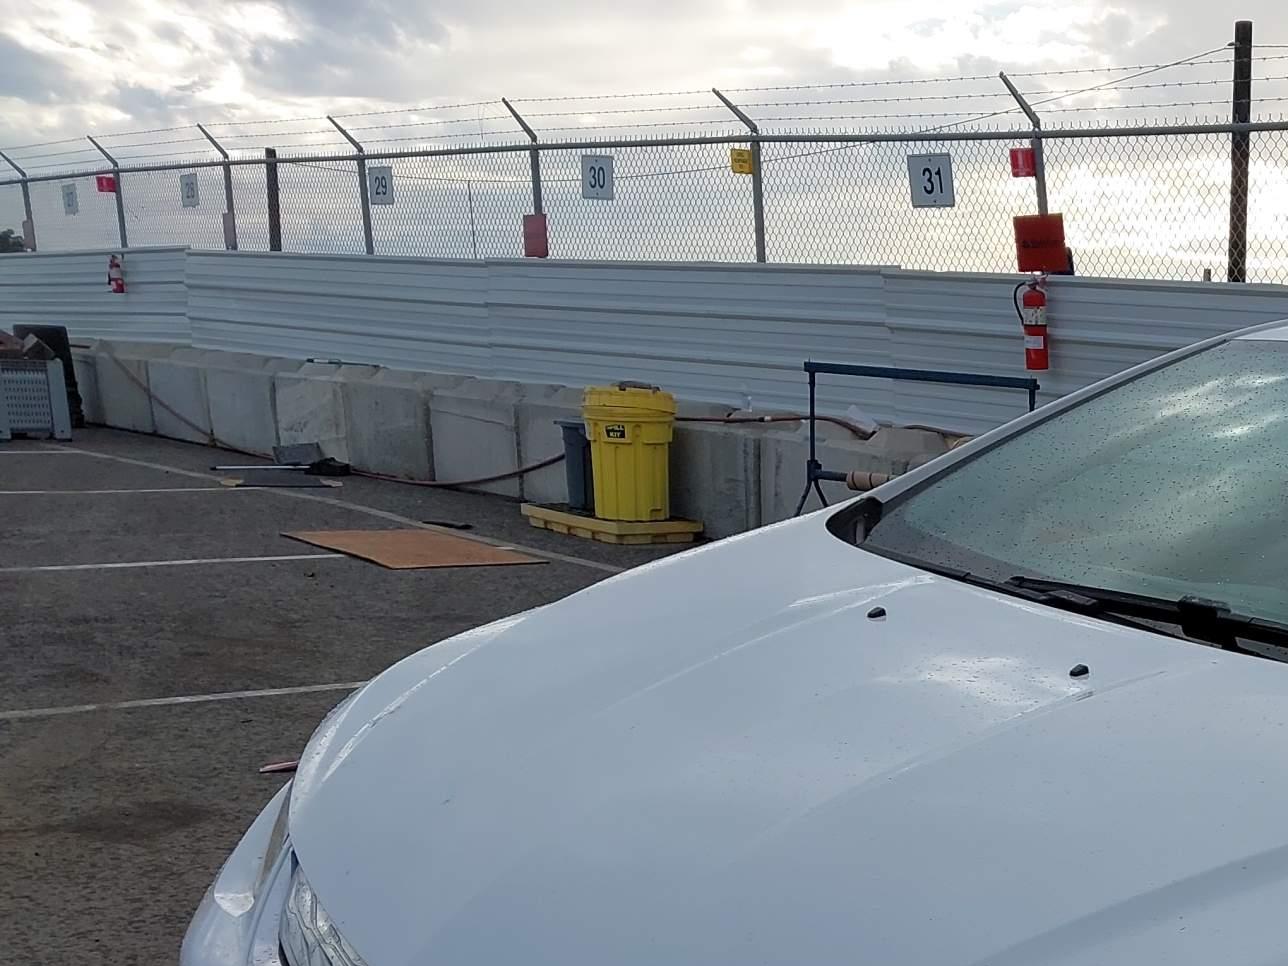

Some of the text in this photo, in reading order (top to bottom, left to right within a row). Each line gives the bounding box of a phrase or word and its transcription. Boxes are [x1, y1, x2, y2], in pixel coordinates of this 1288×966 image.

[374, 175, 388, 196] 29
[588, 165, 606, 190] 30
[922, 166, 943, 195] 31
